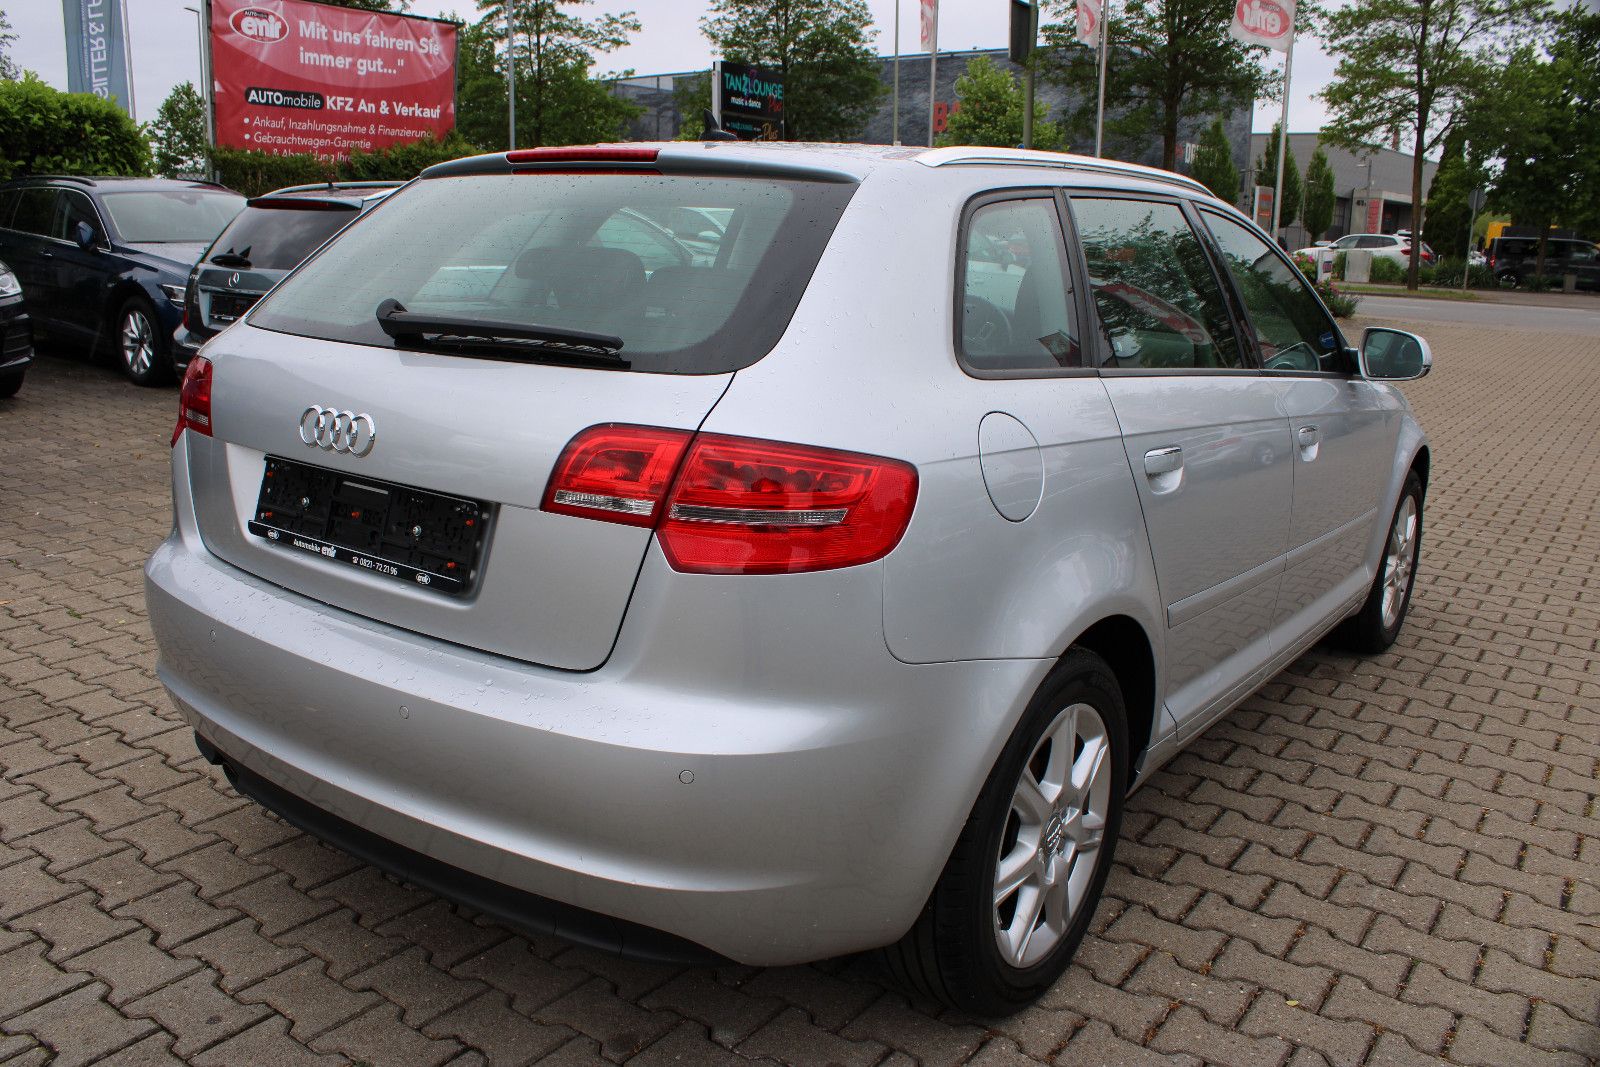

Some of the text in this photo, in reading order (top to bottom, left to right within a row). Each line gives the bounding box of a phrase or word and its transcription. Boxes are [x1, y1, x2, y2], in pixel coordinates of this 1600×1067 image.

[240, 14, 282, 39] emir
[299, 20, 440, 55] Mit uns fahren Sie
[300, 47, 353, 69] immer
[248, 89, 441, 119] AUTOmobile KFZ An & Verkauf
[253, 116, 286, 130] Ankauf,
[289, 119, 367, 134] Inzahlungsnahme
[368, 124, 376, 135] &
[253, 132, 371, 149] Gebrauchtwagen-Garantie
